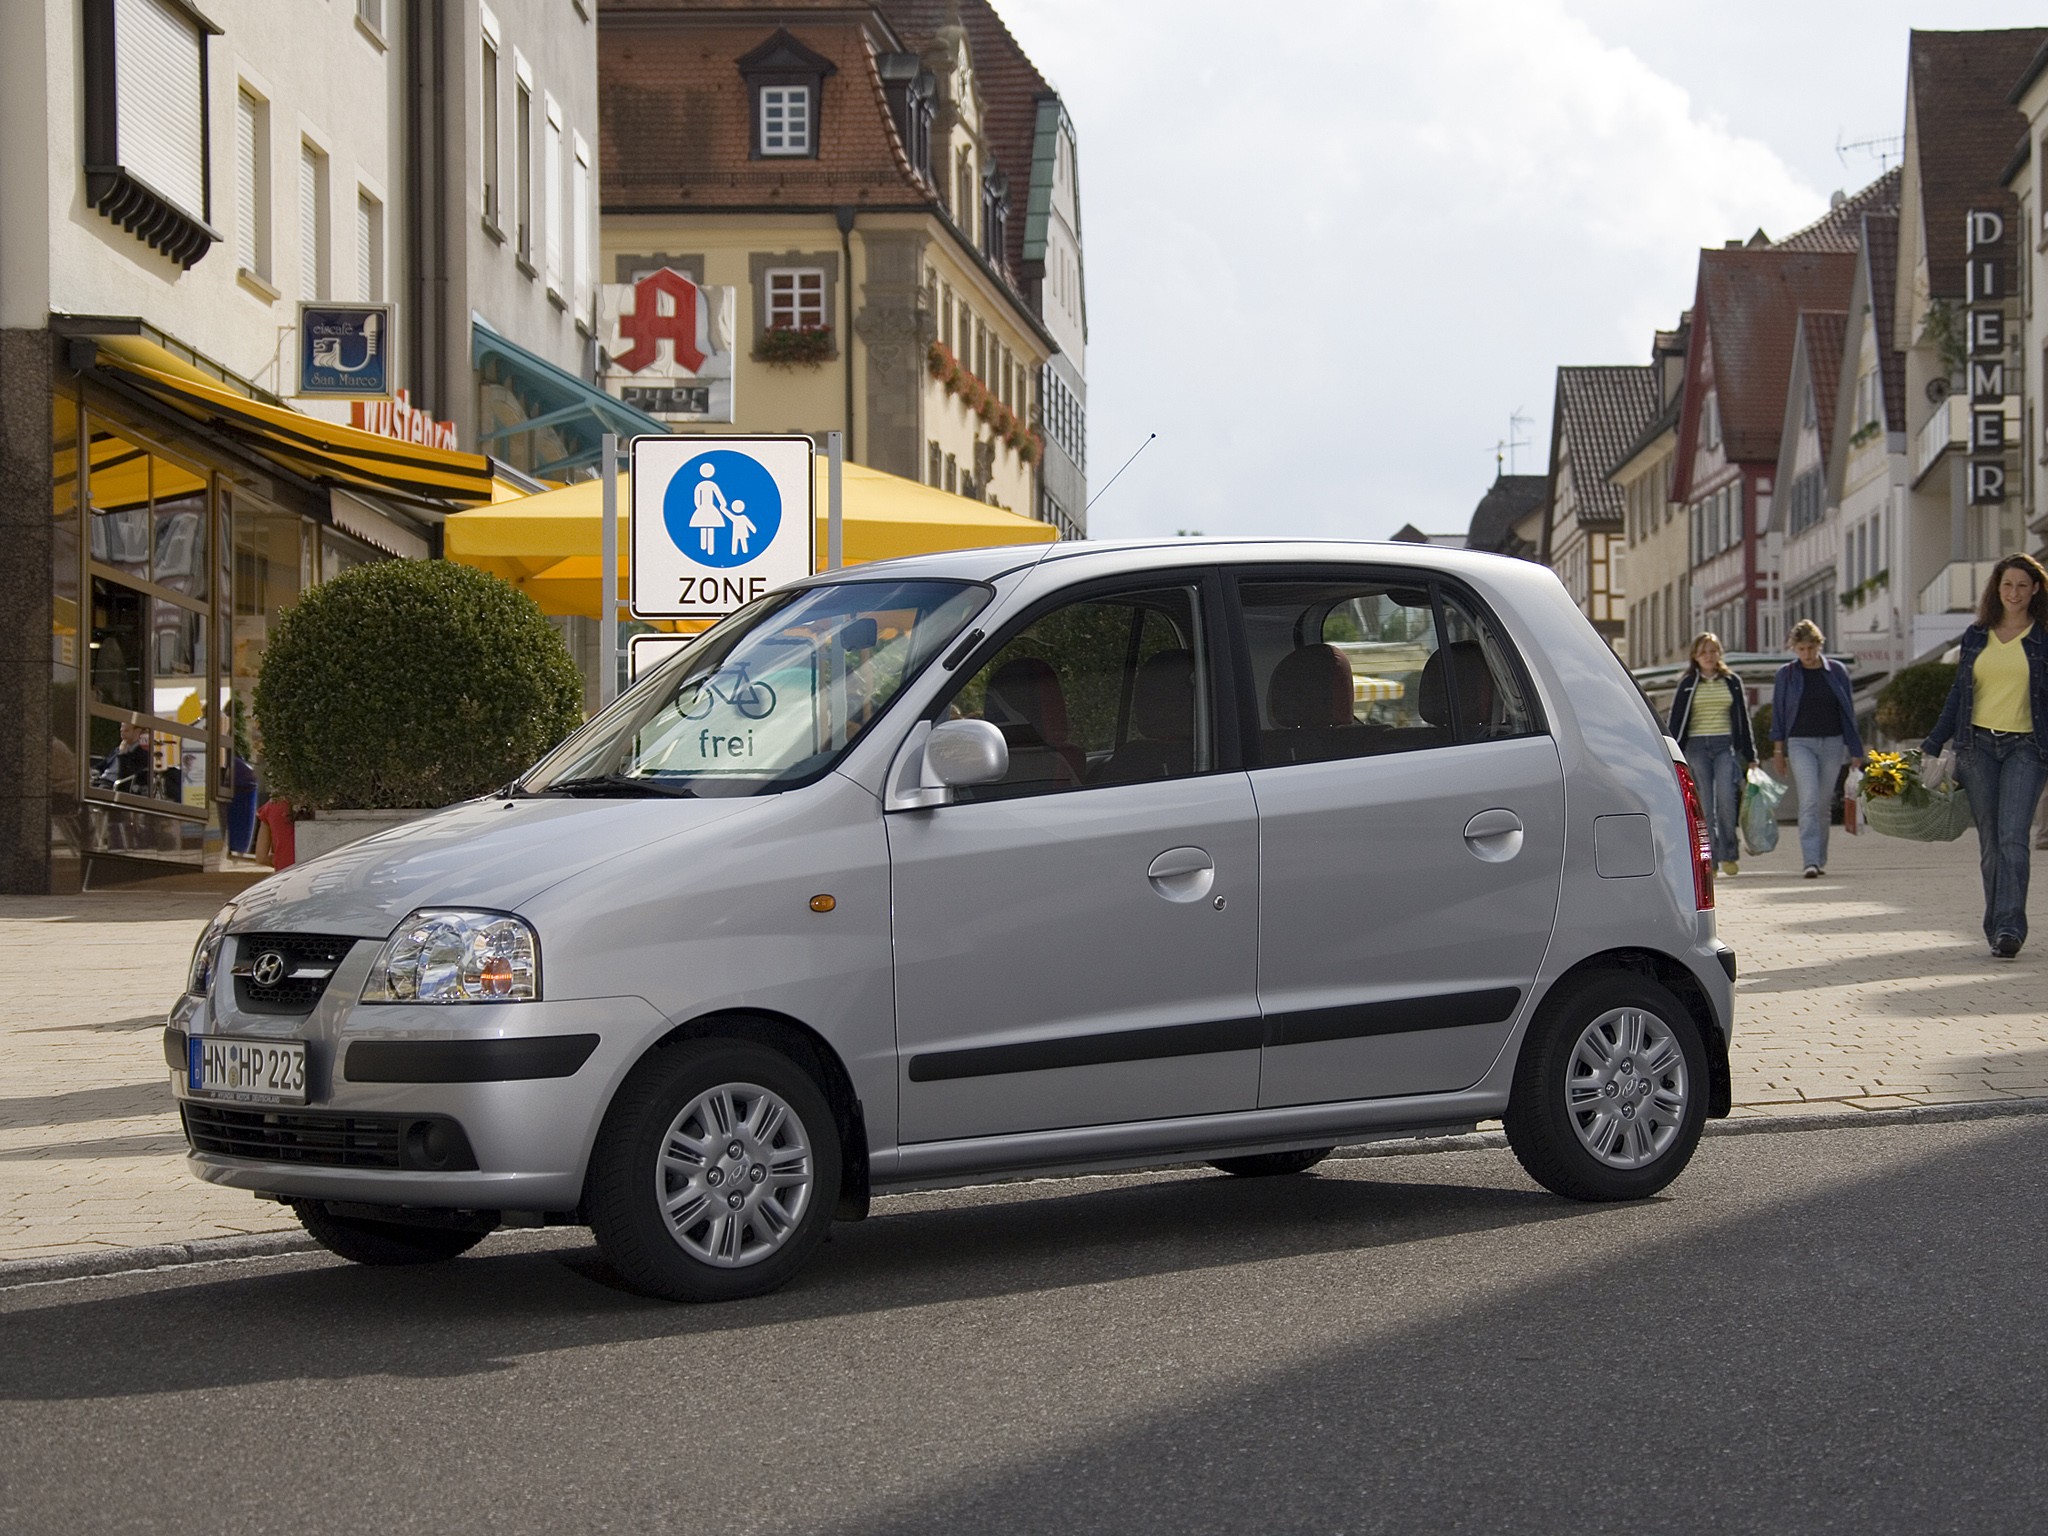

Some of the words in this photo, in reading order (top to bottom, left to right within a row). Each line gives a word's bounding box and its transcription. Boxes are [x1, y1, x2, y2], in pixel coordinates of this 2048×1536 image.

[1974, 211, 2004, 498] DIEMER
[310, 372, 334, 386] San
[339, 373, 377, 387] Marco
[678, 577, 767, 605] ZONE
[699, 729, 753, 758] frei
[202, 1044, 226, 1085] HN
[239, 1046, 264, 1087] HP
[268, 1049, 304, 1091] 223
